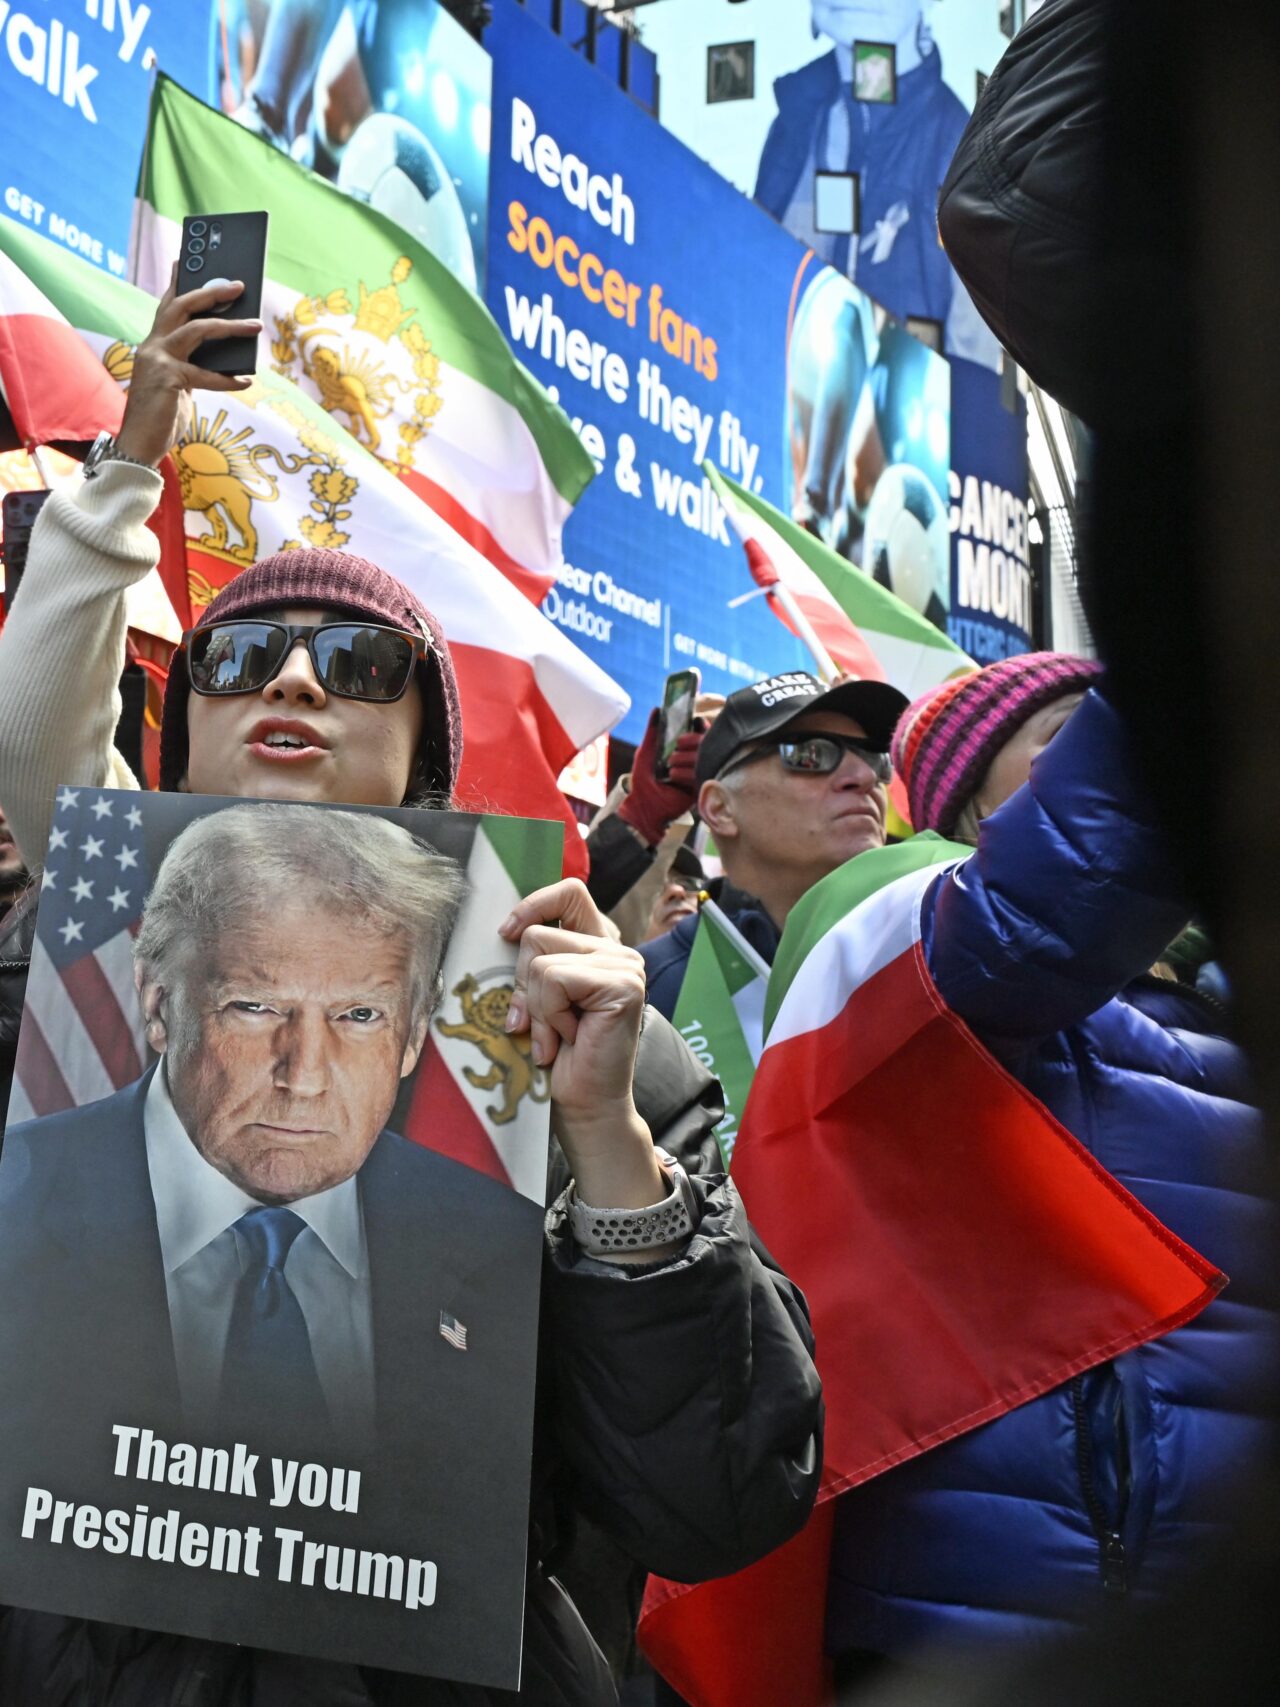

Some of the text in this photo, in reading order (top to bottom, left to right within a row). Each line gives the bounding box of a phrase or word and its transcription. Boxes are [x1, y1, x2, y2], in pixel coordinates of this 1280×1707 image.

[511, 97, 635, 245] Reach
[5, 186, 46, 226] GET
[48, 212, 104, 264] MORE
[507, 201, 718, 381] soccer fans
[504, 285, 629, 403] where
[637, 358, 713, 465] they
[718, 411, 763, 493] fly,
[615, 433, 731, 547] & walk
[948, 470, 1029, 573] CANCE
[542, 587, 613, 643] Outdoor
[592, 571, 662, 628] Channel
[752, 673, 812, 695] MAKE
[761, 685, 819, 707] GREAT
[112, 1424, 361, 1513] Thank you
[21, 1487, 438, 1610] President Trump
